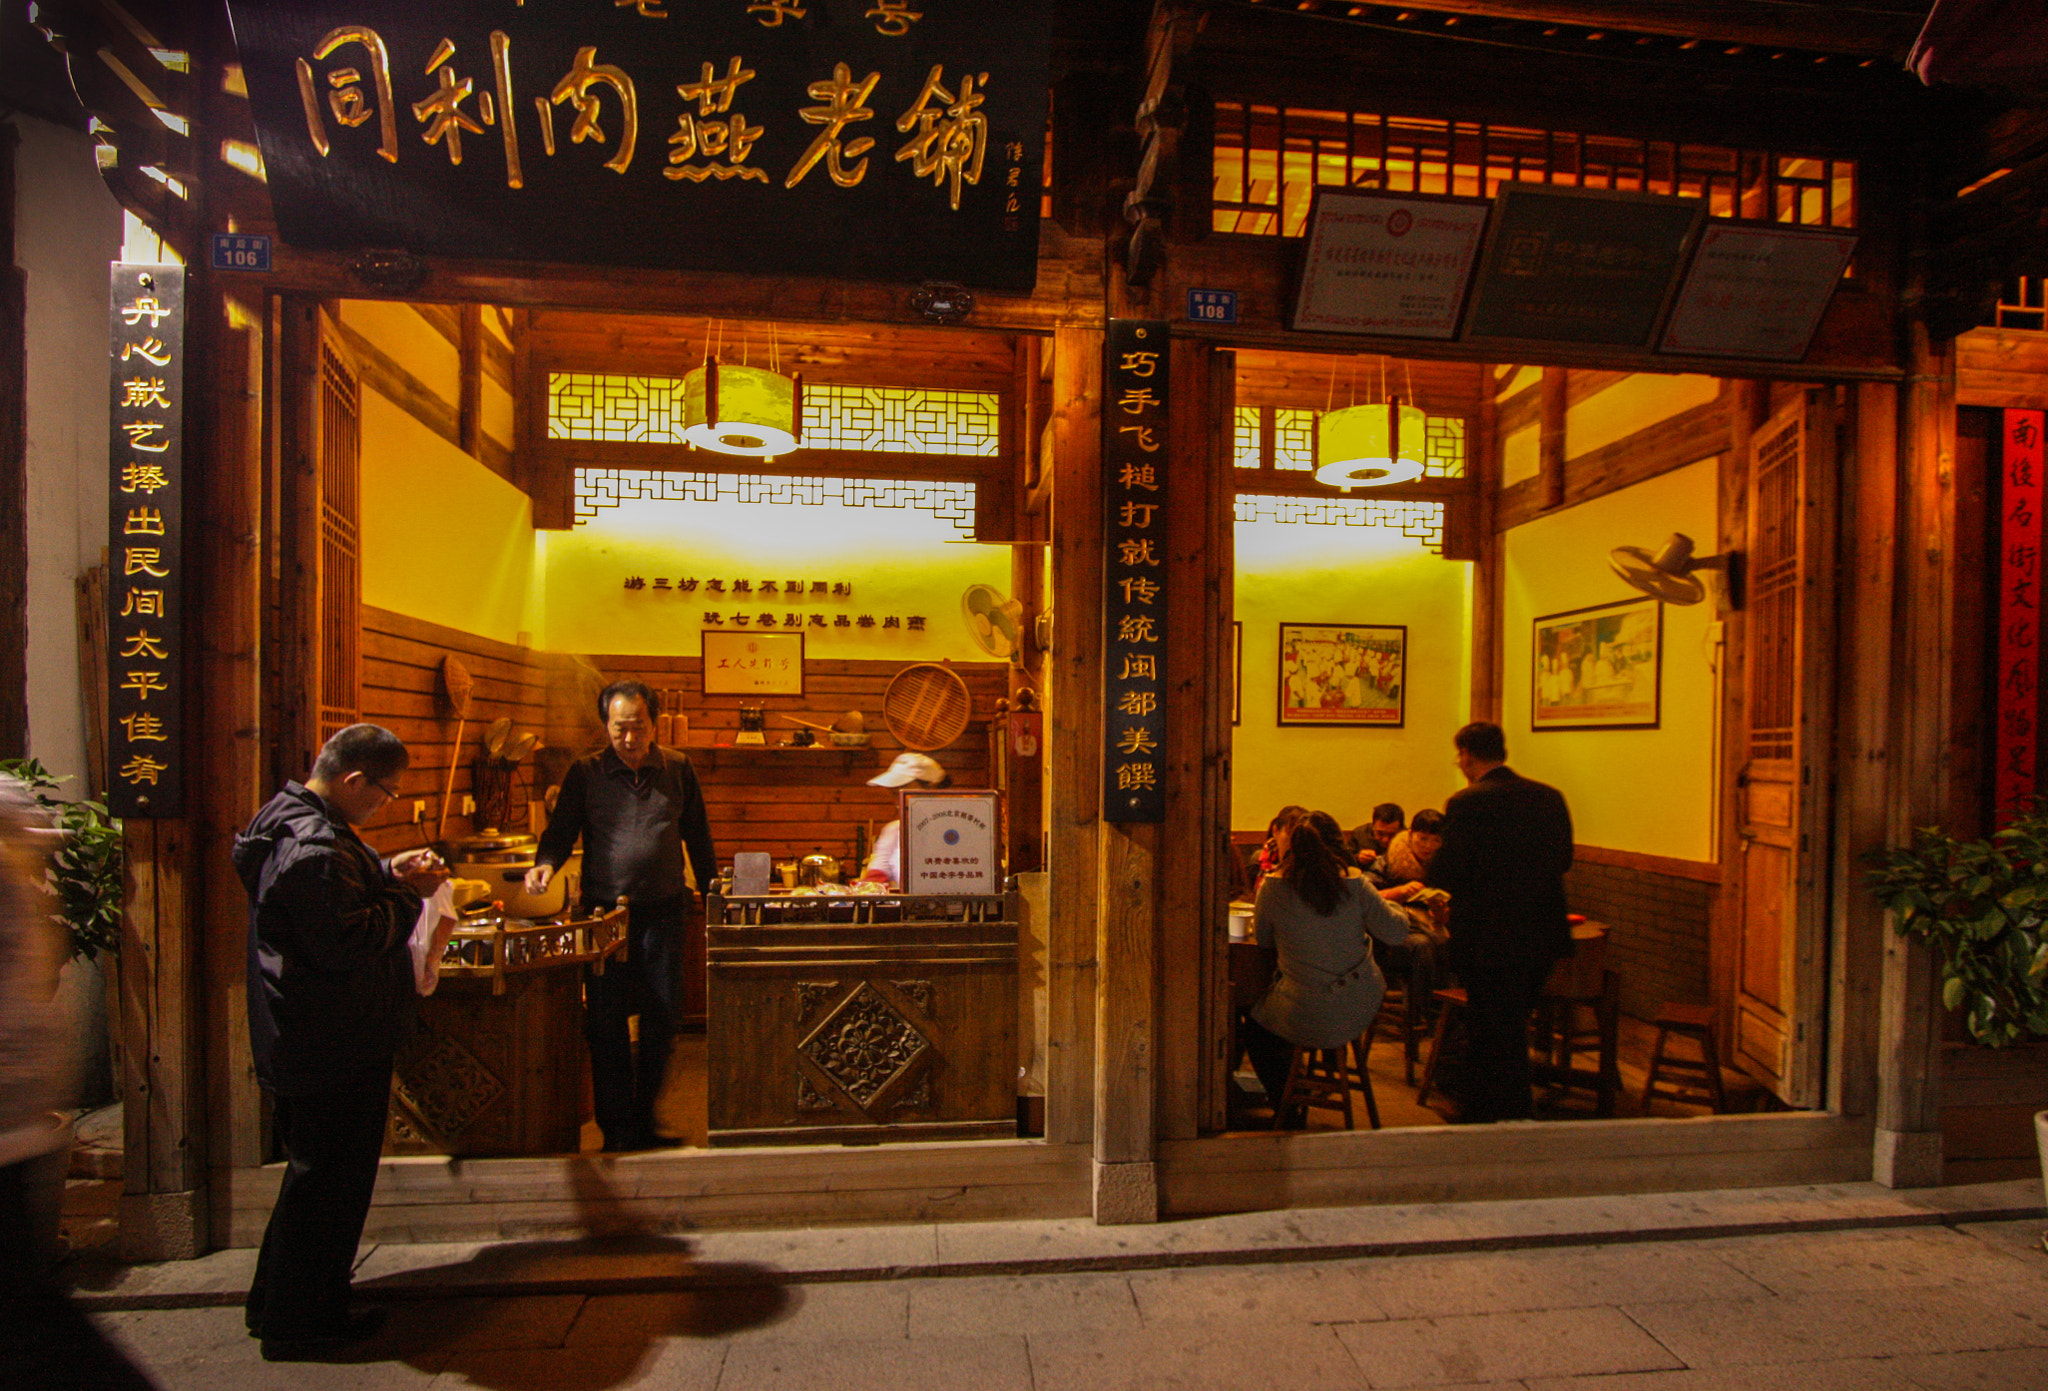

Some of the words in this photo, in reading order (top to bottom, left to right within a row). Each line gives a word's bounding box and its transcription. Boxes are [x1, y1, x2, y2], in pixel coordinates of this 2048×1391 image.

[296, 25, 990, 211] 同利肉燕老铺
[223, 250, 258, 266] 106
[1197, 304, 1226, 319] 108
[119, 296, 171, 786] 丹心献艺捧出民间太平佳肴
[920, 871, 984, 880] 中国老字号品牌
